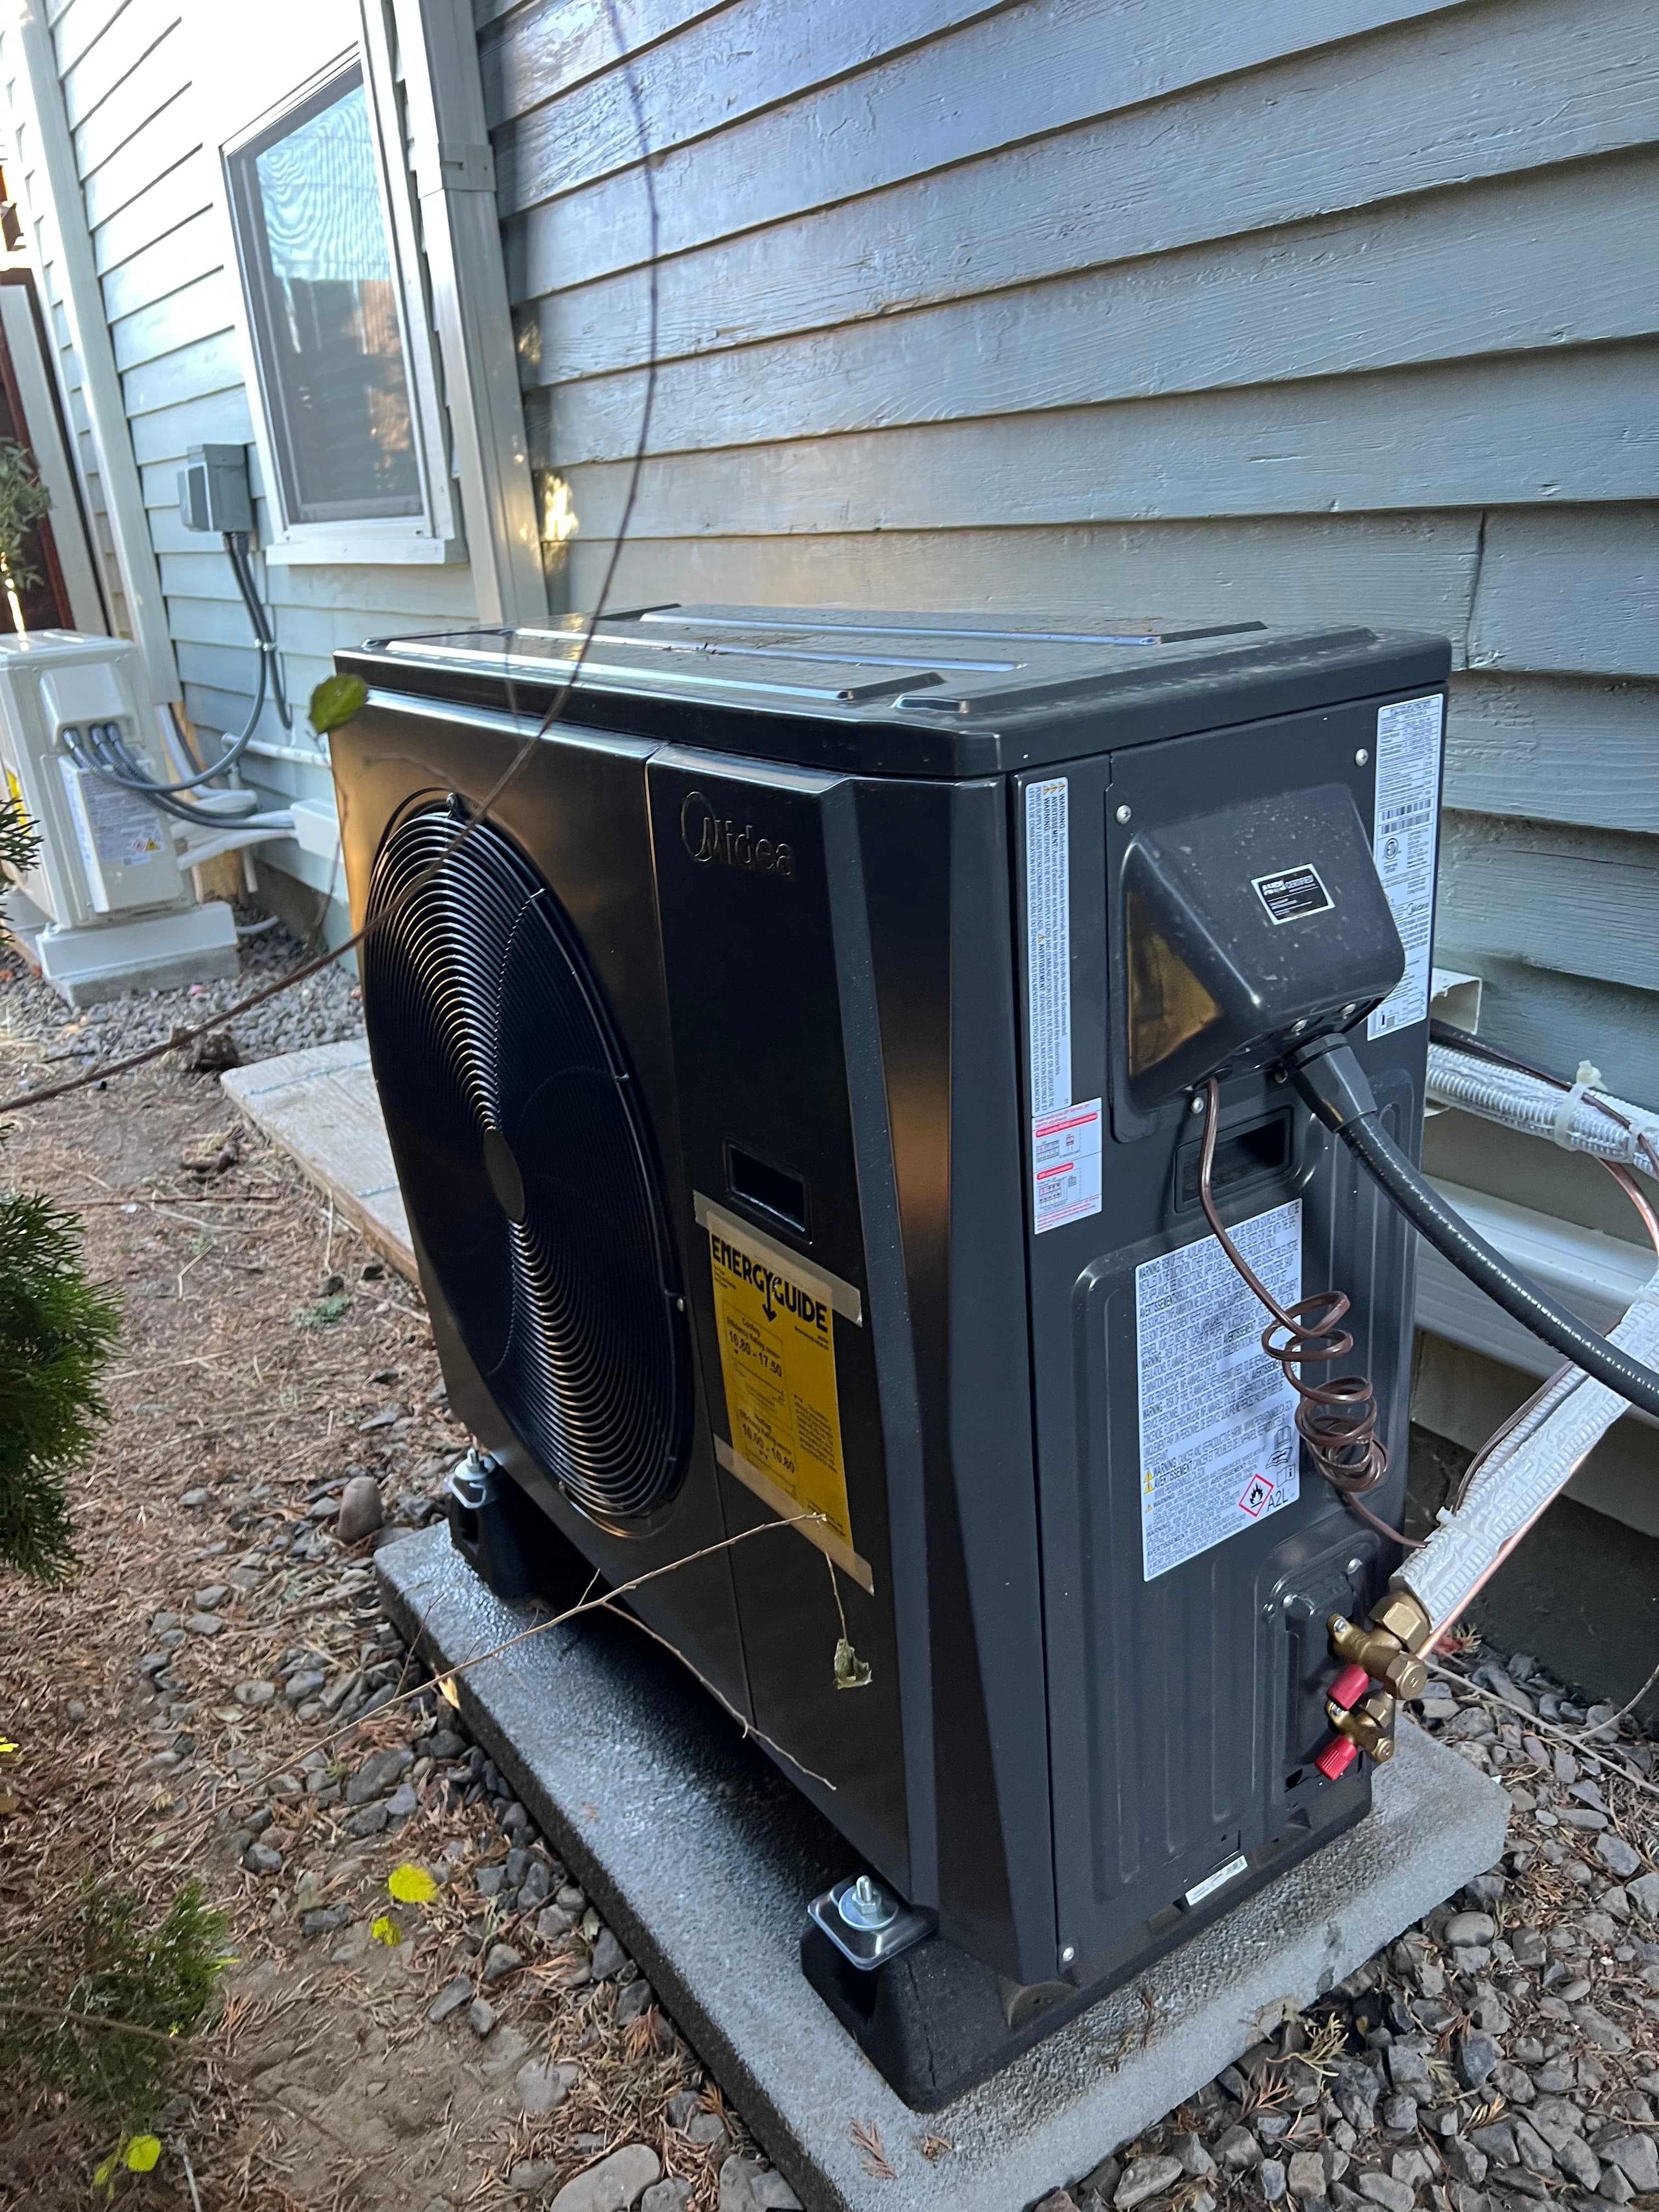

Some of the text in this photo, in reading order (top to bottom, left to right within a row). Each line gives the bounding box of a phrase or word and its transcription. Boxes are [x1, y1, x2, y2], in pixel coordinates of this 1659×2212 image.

[680, 791, 795, 879] Midea
[711, 1234, 828, 1333] ENERGYGUIDE
[759, 1352, 782, 1378] 17.50
[1267, 1487, 1288, 1513] A2L
